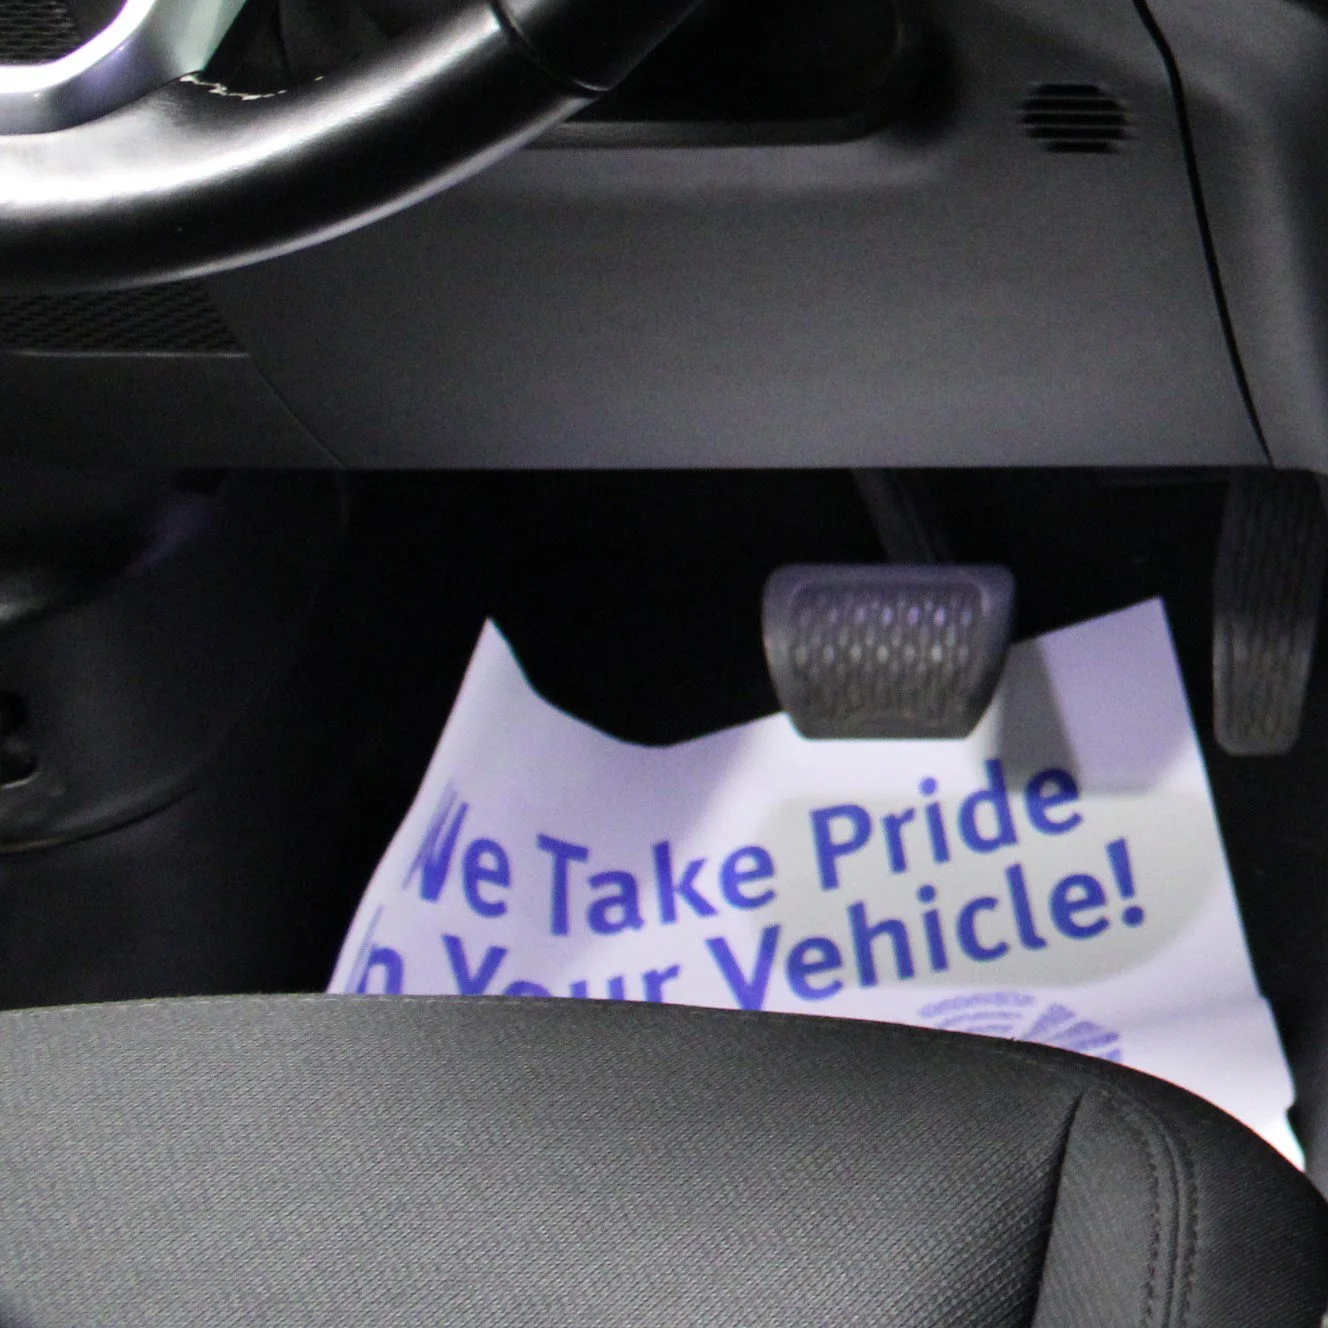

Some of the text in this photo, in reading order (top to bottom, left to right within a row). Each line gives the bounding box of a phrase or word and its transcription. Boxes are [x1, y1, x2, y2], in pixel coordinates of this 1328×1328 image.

[536, 832, 777, 938] Take
[808, 756, 1083, 891] Pride
[705, 837, 1147, 1011] Vehicle!
